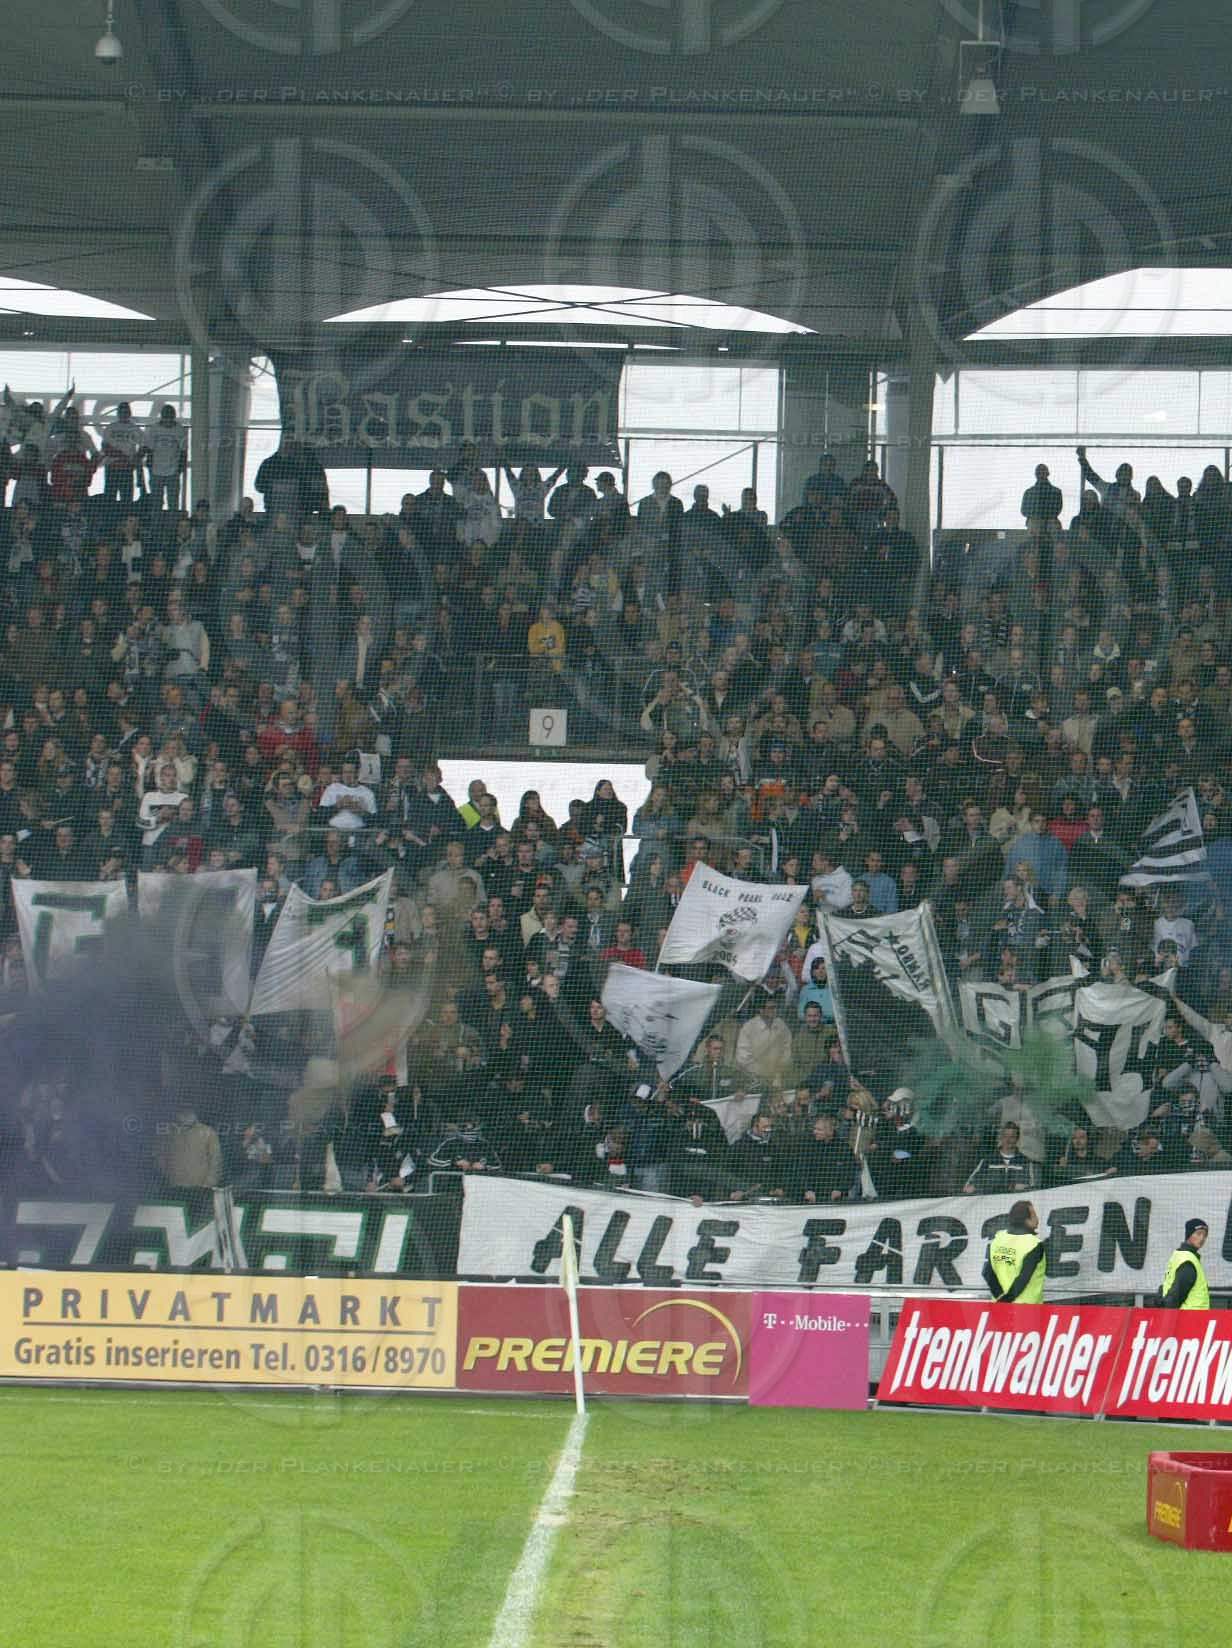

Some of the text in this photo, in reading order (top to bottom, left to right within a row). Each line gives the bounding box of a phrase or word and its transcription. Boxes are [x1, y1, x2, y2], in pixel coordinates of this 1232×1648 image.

[281, 370, 614, 447] Bastion
[542, 715, 555, 739] 9
[530, 1205, 740, 1286] ALLE
[22, 1286, 443, 1329] PRIVATMARKT
[14, 1336, 96, 1367] Gratis
[105, 1337, 241, 1370] inserieren
[250, 1342, 296, 1373] Tel.
[462, 1335, 727, 1377] PREMIERE
[890, 1310, 1112, 1406] trenkwalder
